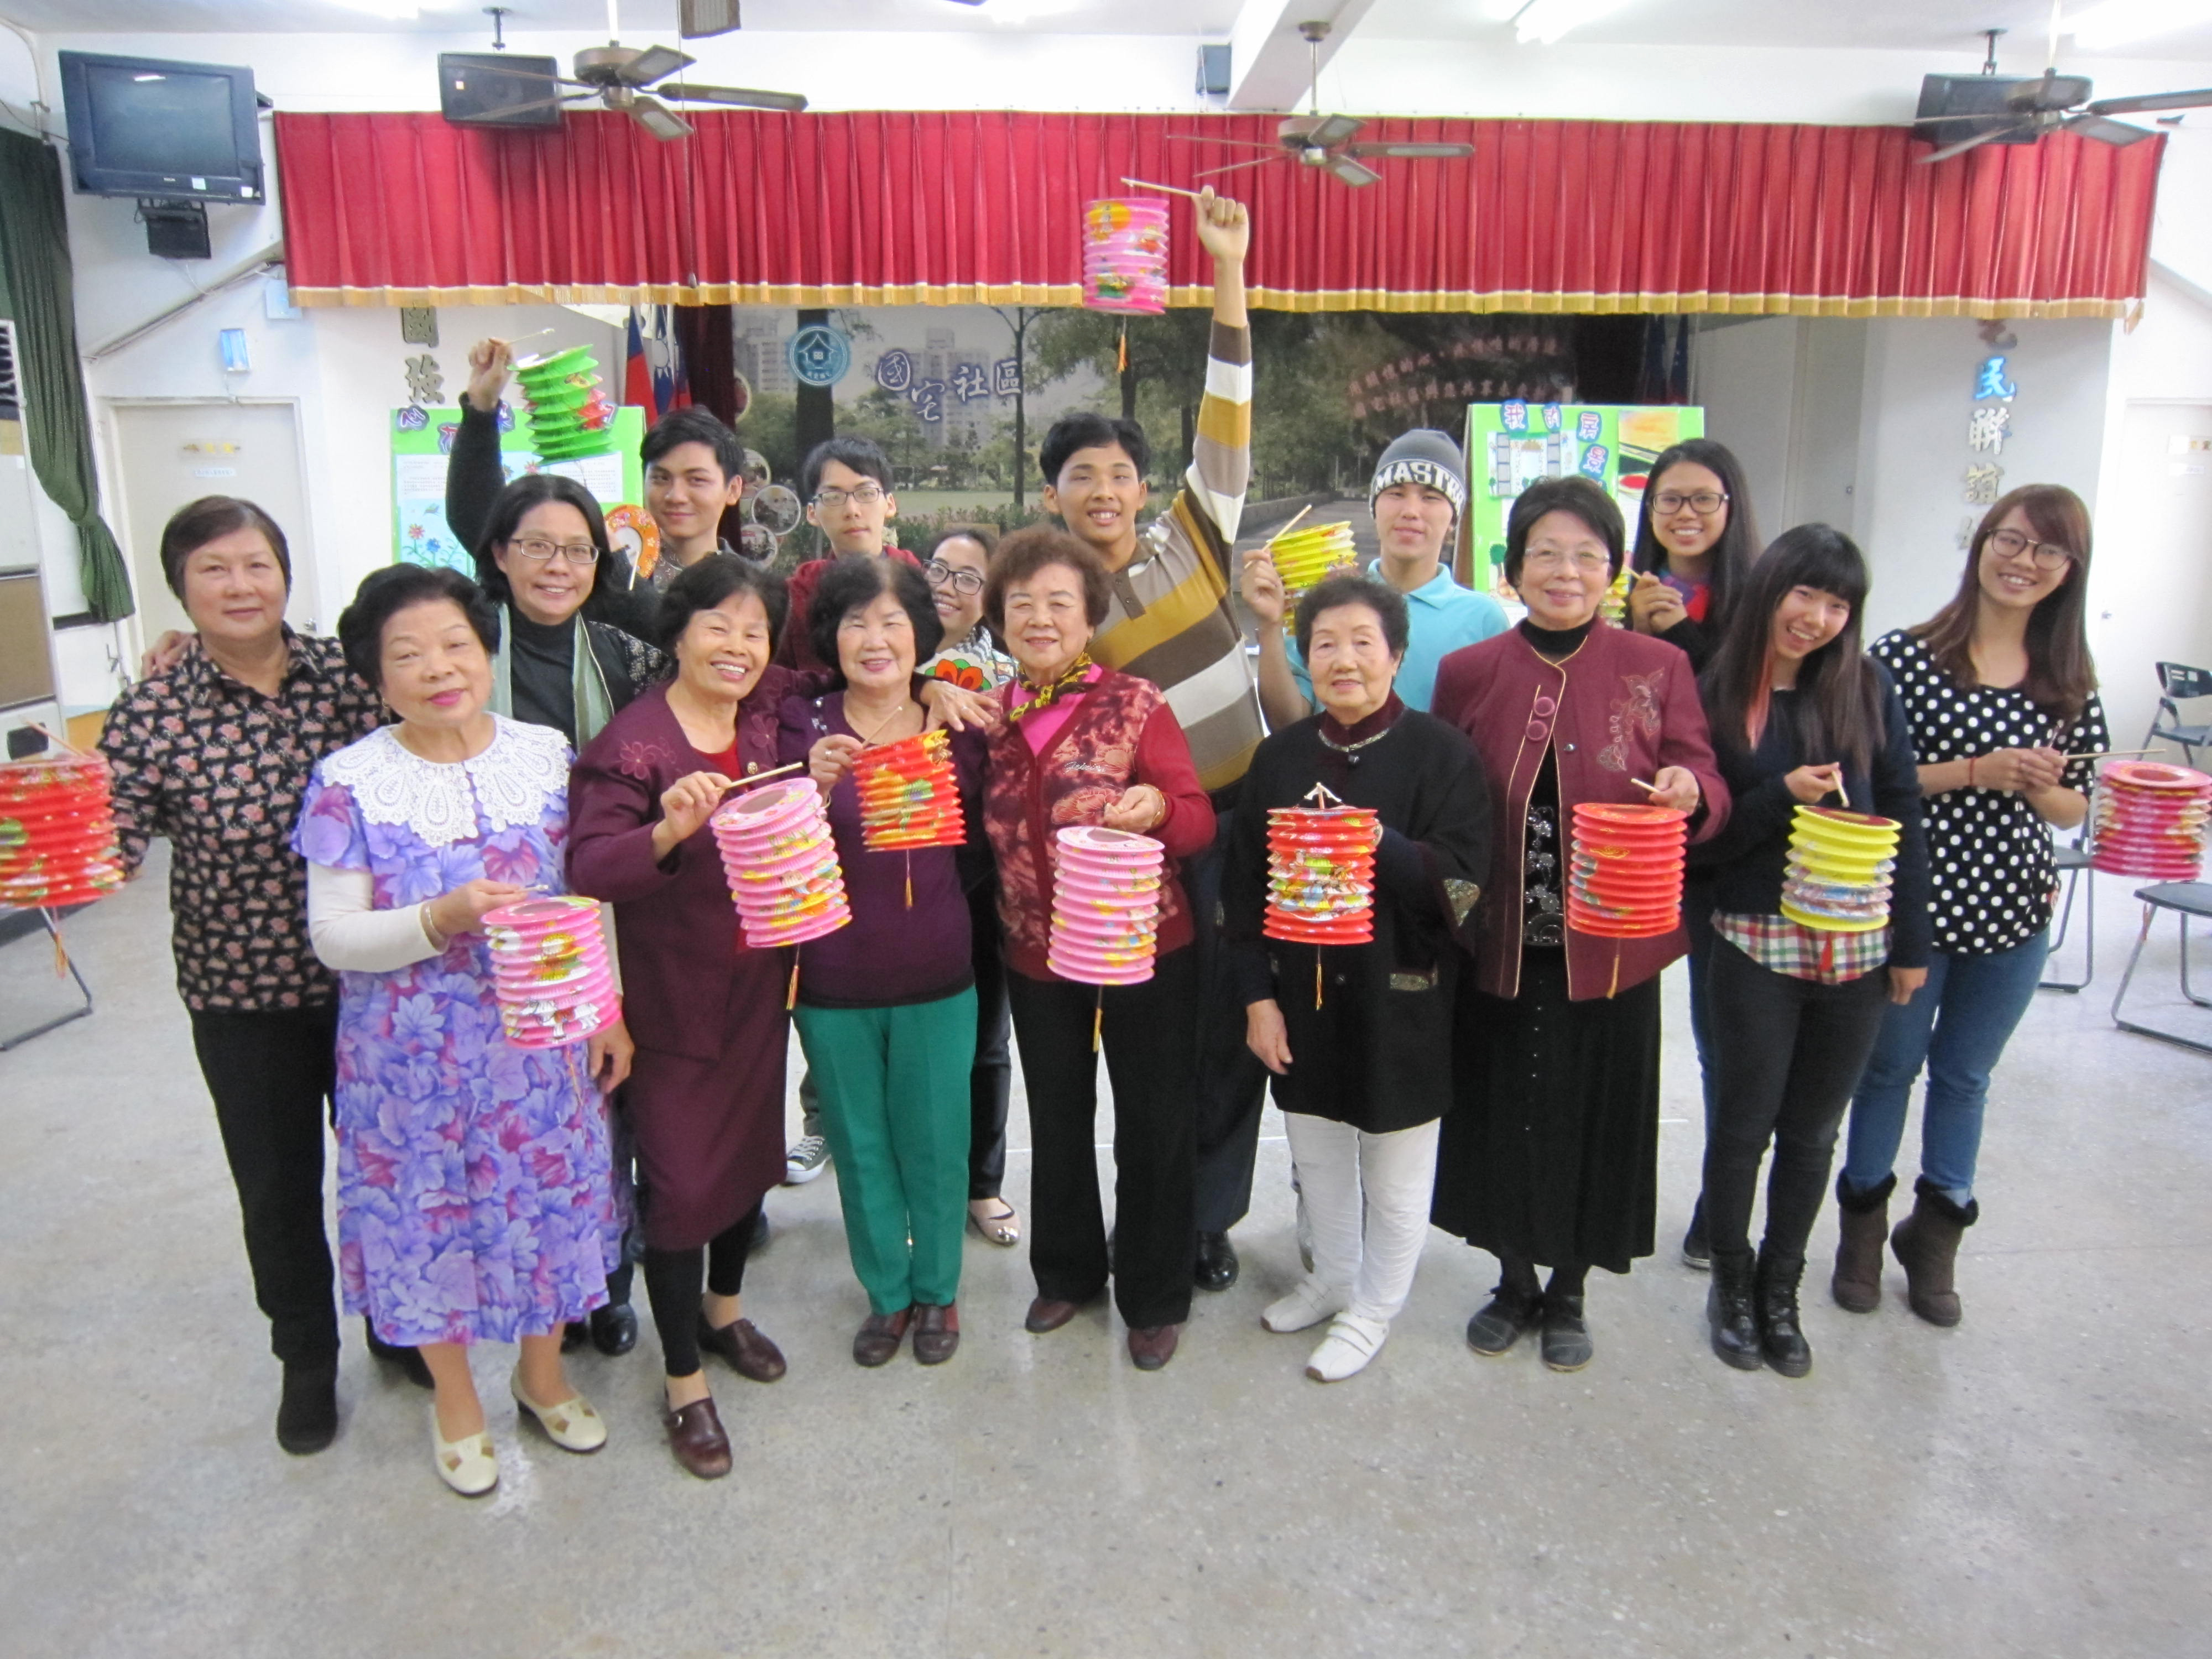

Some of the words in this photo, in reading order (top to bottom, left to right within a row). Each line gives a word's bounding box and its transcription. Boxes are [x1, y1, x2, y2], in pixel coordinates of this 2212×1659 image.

[878, 352, 1021, 421] 國宅社區
[1503, 403, 1606, 488] 我的房景
